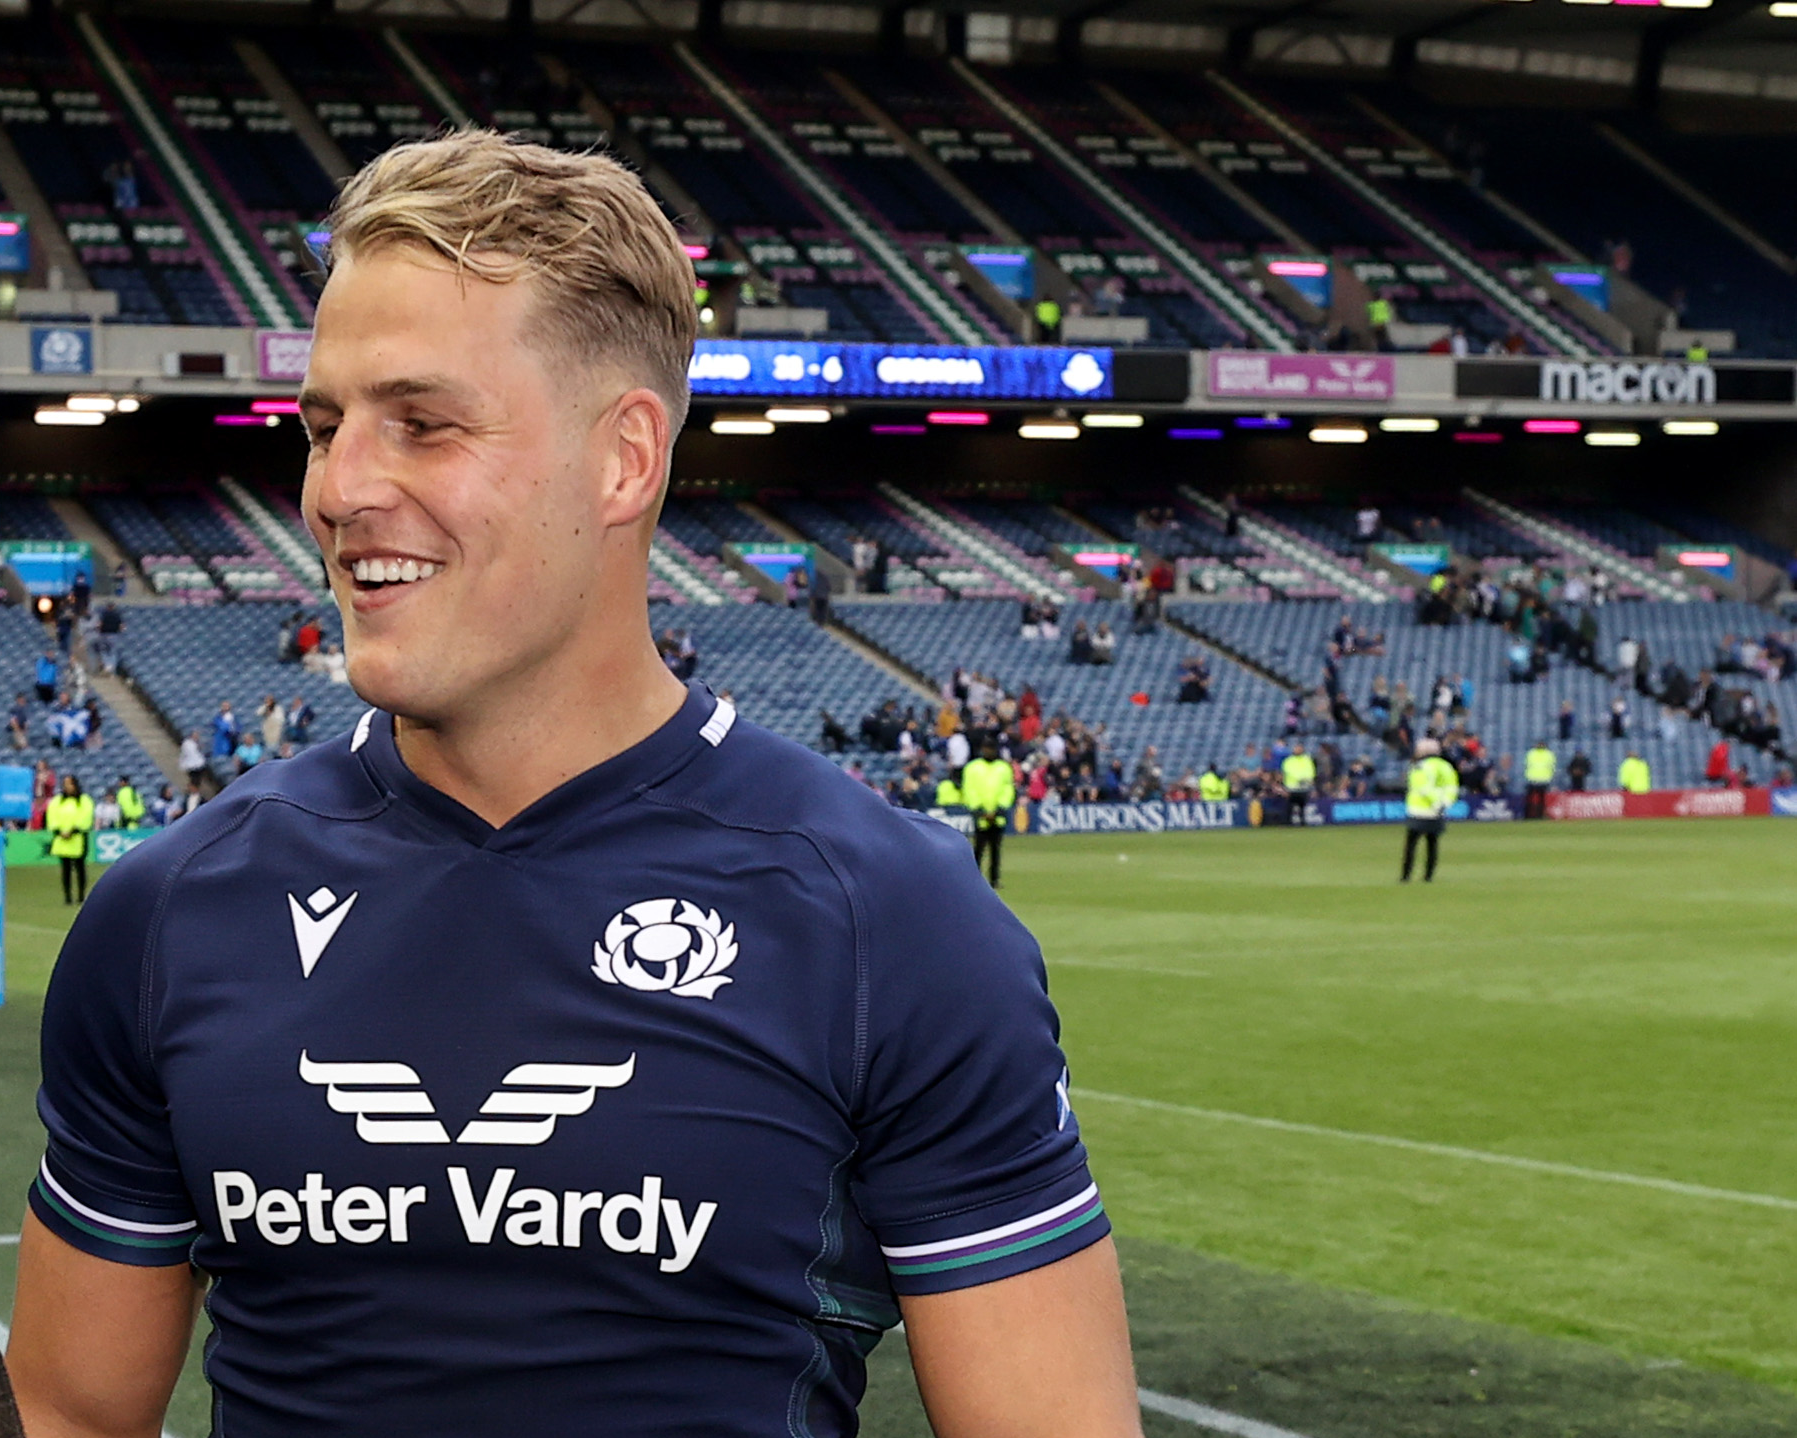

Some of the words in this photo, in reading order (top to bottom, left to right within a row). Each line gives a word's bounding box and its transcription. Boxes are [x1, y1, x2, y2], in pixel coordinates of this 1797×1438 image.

[1167, 801, 1237, 827] MALT
[212, 1170, 427, 1246] Peter
[446, 1166, 719, 1275] Vardy
